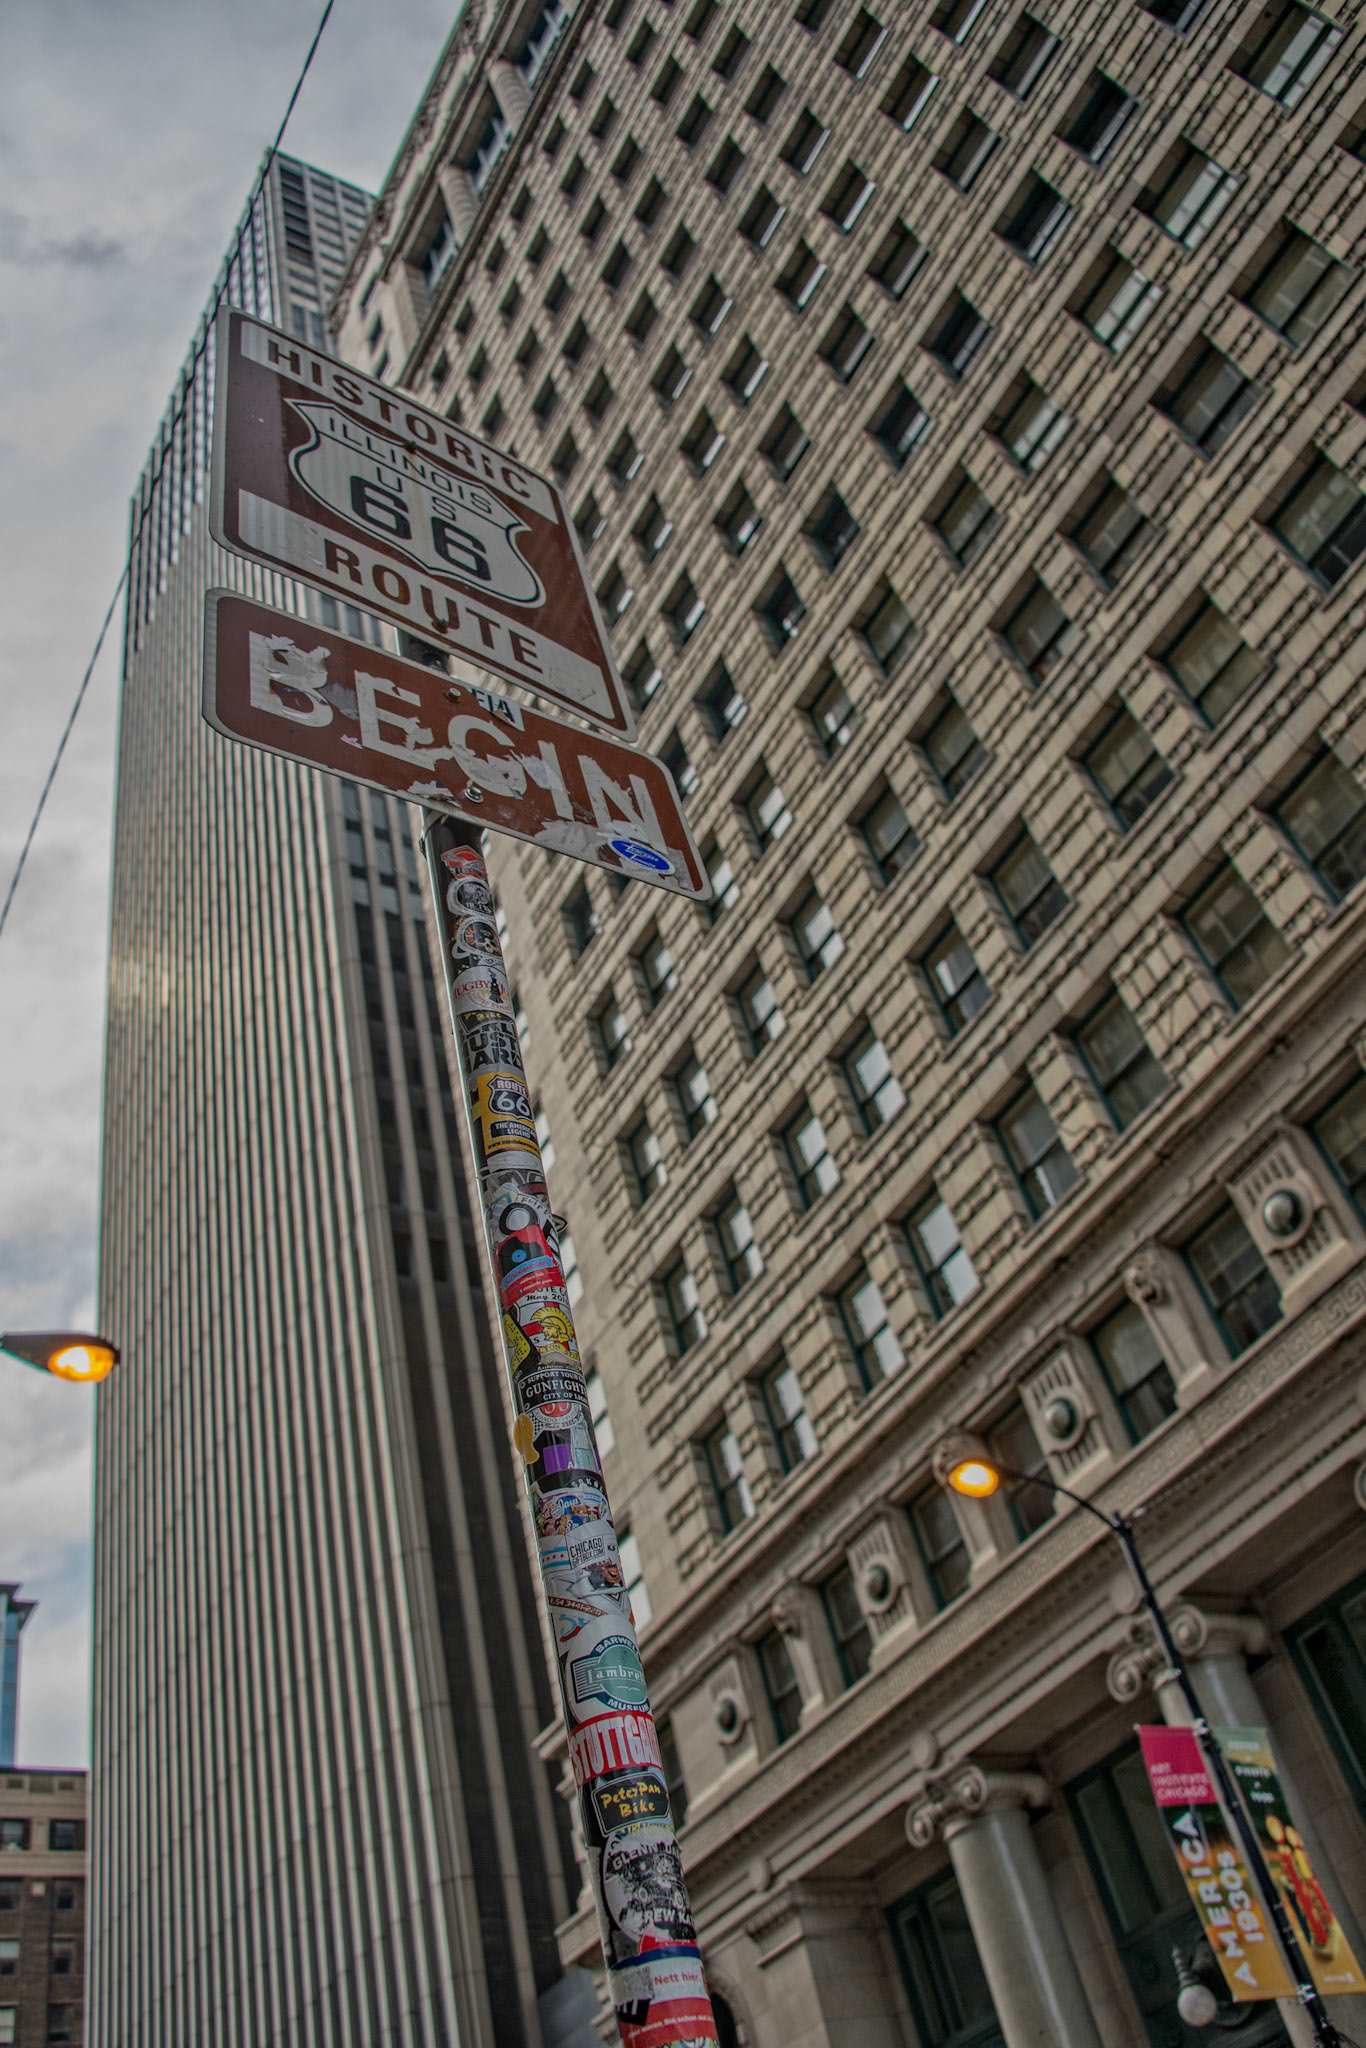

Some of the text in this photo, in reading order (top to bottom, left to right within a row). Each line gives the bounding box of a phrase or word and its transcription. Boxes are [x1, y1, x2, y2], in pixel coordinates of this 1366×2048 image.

[268, 339, 530, 498] HISTORIC
[329, 417, 491, 514] ILLINOIS
[351, 474, 491, 582] 66
[325, 537, 543, 675] ROUTE
[249, 630, 667, 852] BEGIN
[496, 1080, 527, 1096] ROUTE
[496, 1091, 530, 1117] 66
[507, 1128, 530, 1139] LEGEND
[527, 1371, 559, 1384] SUPPORT
[561, 1371, 577, 1380] YOUR
[543, 1392, 561, 1401] CITY
[570, 1538, 603, 1558] CHICAGO
[607, 1698, 650, 1712] MUSEUM
[1157, 1785, 1209, 1800] CHICAGO
[619, 1801, 656, 1817] Bike
[1172, 1812, 1258, 1987] AMERICA
[654, 1973, 680, 1985] Nett
